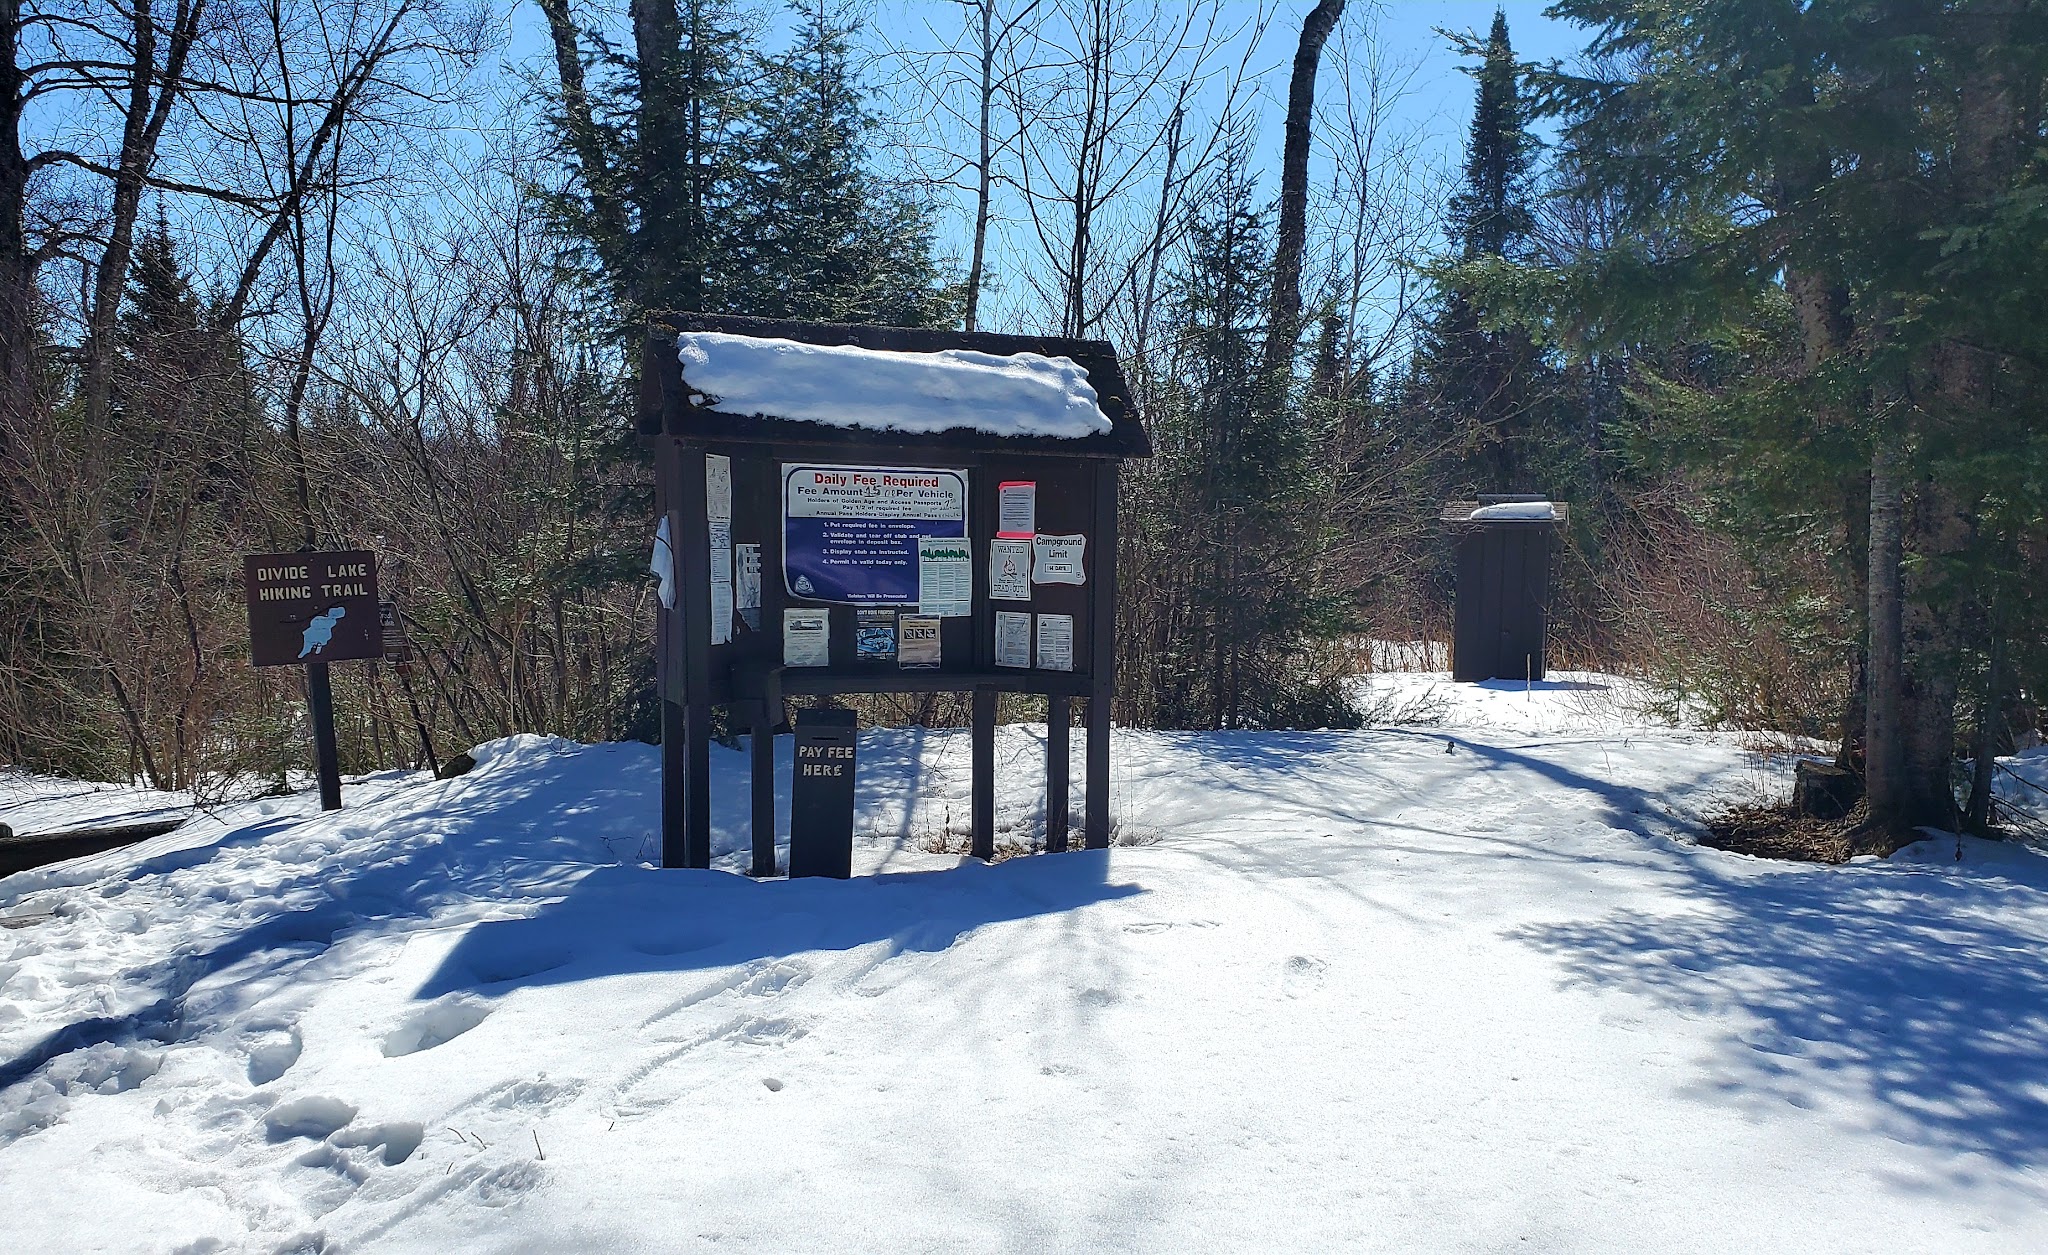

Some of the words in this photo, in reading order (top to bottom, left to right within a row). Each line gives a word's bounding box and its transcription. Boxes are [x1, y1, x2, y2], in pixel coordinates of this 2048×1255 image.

[814, 472, 847, 486] Daily
[854, 474, 877, 485] Fee
[883, 476, 939, 488] Required
[798, 487, 817, 495] Fee
[822, 487, 863, 496] Amount
[896, 490, 913, 498] Per
[918, 490, 954, 498] Vehicle
[1036, 537, 1082, 548] Campground
[997, 545, 1024, 554] WANTED
[1048, 549, 1068, 558] Limit
[257, 566, 309, 582] DIVIDE
[327, 563, 367, 578] LAKE
[259, 586, 311, 601] HIKING
[321, 583, 368, 597] TRAIL
[798, 746, 824, 758] PAY
[828, 747, 854, 759] FEE
[803, 764, 843, 777] HERE
